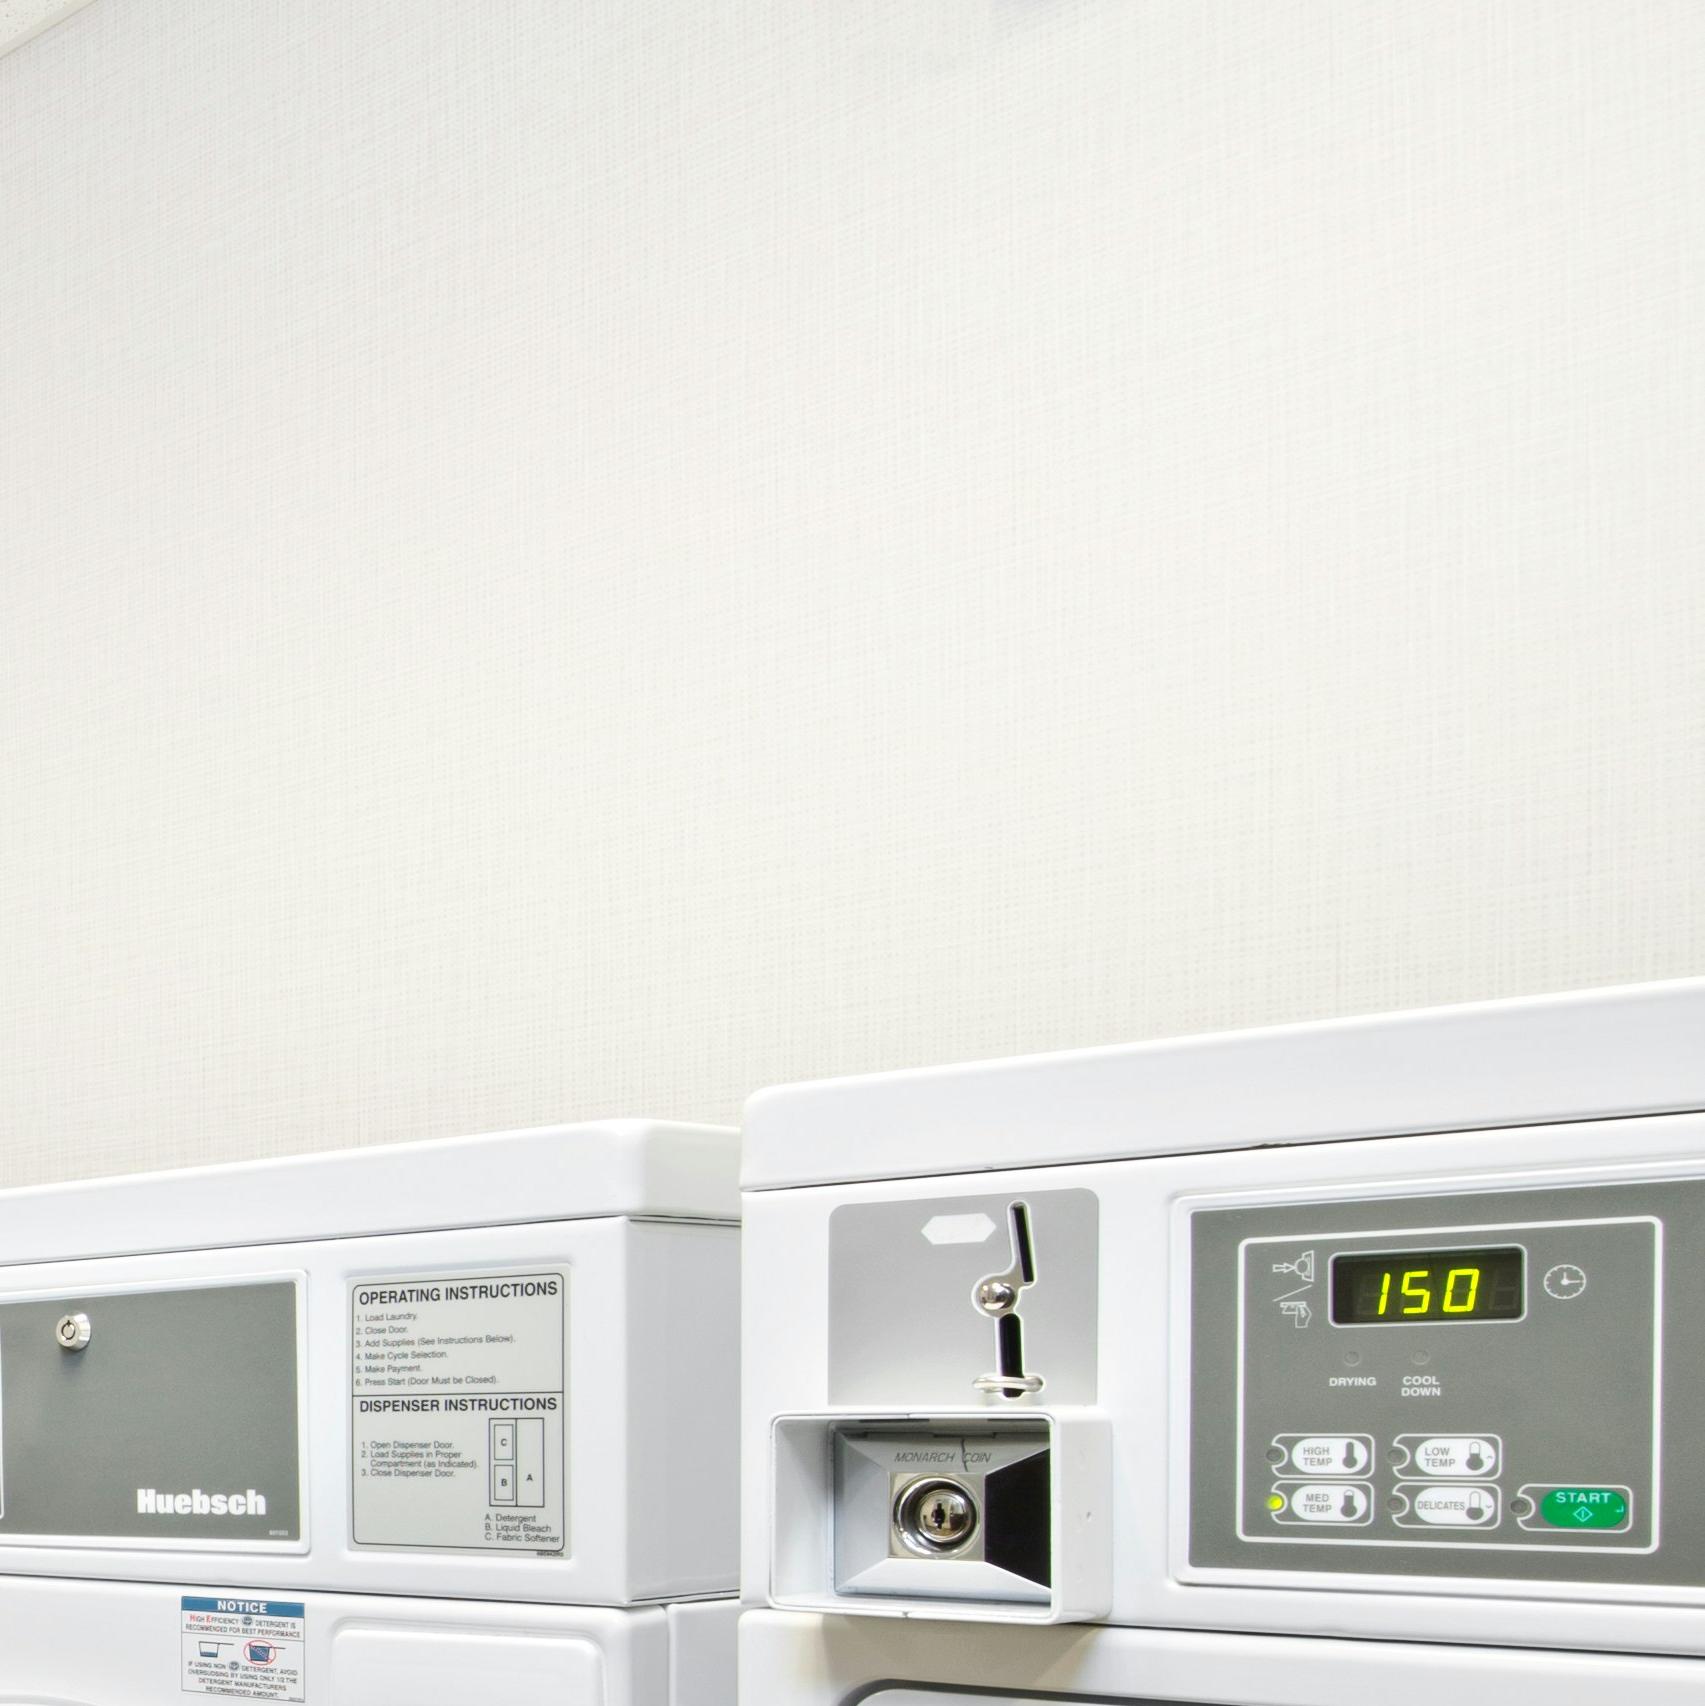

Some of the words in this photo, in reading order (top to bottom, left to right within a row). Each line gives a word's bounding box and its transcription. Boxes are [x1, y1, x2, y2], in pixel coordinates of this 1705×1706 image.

[359, 1288, 440, 1305] OPERATING
[445, 1281, 558, 1300] INSTRUCTIONS
[1377, 1268, 1480, 1315] 150
[365, 1313, 384, 1322] Load
[386, 1312, 418, 1322] Laundry.
[365, 1327, 386, 1335] Close
[388, 1326, 409, 1334] Door.
[356, 1340, 363, 1348] 3.
[365, 1339, 380, 1347] Add
[382, 1338, 415, 1348] Supplies
[417, 1337, 435, 1347] (See
[437, 1335, 483, 1345] Instructions
[485, 1334, 516, 1344] Below).
[356, 1353, 363, 1361] 4.
[365, 1352, 385, 1361] Make
[387, 1351, 409, 1361] Cycle
[411, 1350, 448, 1359] Selection.
[356, 1366, 363, 1374] 5.
[365, 1365, 385, 1373] Make
[387, 1364, 422, 1374] Payment.
[365, 1378, 386, 1386] Press
[388, 1377, 406, 1386] Start
[407, 1377, 430, 1386] (Door
[431, 1376, 451, 1385] Must
[452, 1376, 463, 1384] be
[465, 1375, 499, 1385] Closed).
[1329, 1377, 1377, 1387] DRYING
[1402, 1376, 1440, 1386] COOL
[1401, 1387, 1441, 1397] DOWN
[359, 1400, 440, 1413] DISPENSER
[444, 1397, 557, 1411] INSTRUCTIONS
[370, 1441, 390, 1450] Open
[393, 1441, 431, 1450] Dispenser
[434, 1441, 454, 1449] Door.
[391, 1451, 424, 1459] Supplies
[435, 1451, 461, 1460] Proper
[1302, 1447, 1331, 1456] HIGH
[1424, 1447, 1450, 1457] LOW
[894, 1452, 955, 1463] MONARCH
[963, 1452, 991, 1463] COIN
[1302, 1457, 1333, 1467] TEMP
[370, 1460, 422, 1469] Compartment
[424, 1460, 435, 1469] (as
[438, 1460, 478, 1469] Indicated).
[1424, 1458, 1456, 1468] TEMP
[361, 1469, 368, 1477] 3.
[370, 1469, 392, 1477] Close
[394, 1469, 432, 1478] Dispenser
[435, 1469, 456, 1477] Door.
[526, 1474, 533, 1482] A
[137, 1489, 266, 1515] Huebsch
[1305, 1493, 1330, 1502] MED
[1556, 1492, 1611, 1503] START
[1302, 1503, 1332, 1513] TEMP
[1417, 1501, 1466, 1511] DELICATES
[485, 1514, 493, 1522] A.
[495, 1514, 536, 1524] Detergent
[485, 1523, 493, 1531] B.
[495, 1523, 521, 1533] Liquid
[523, 1524, 551, 1532] Bleach
[485, 1533, 493, 1541] C.
[496, 1533, 522, 1542] Fabric
[524, 1534, 560, 1543] Softener
[217, 1601, 267, 1613] NOTICE
[255, 1620, 289, 1628] DETERGENT
[257, 1629, 300, 1638] PERFORMANCE
